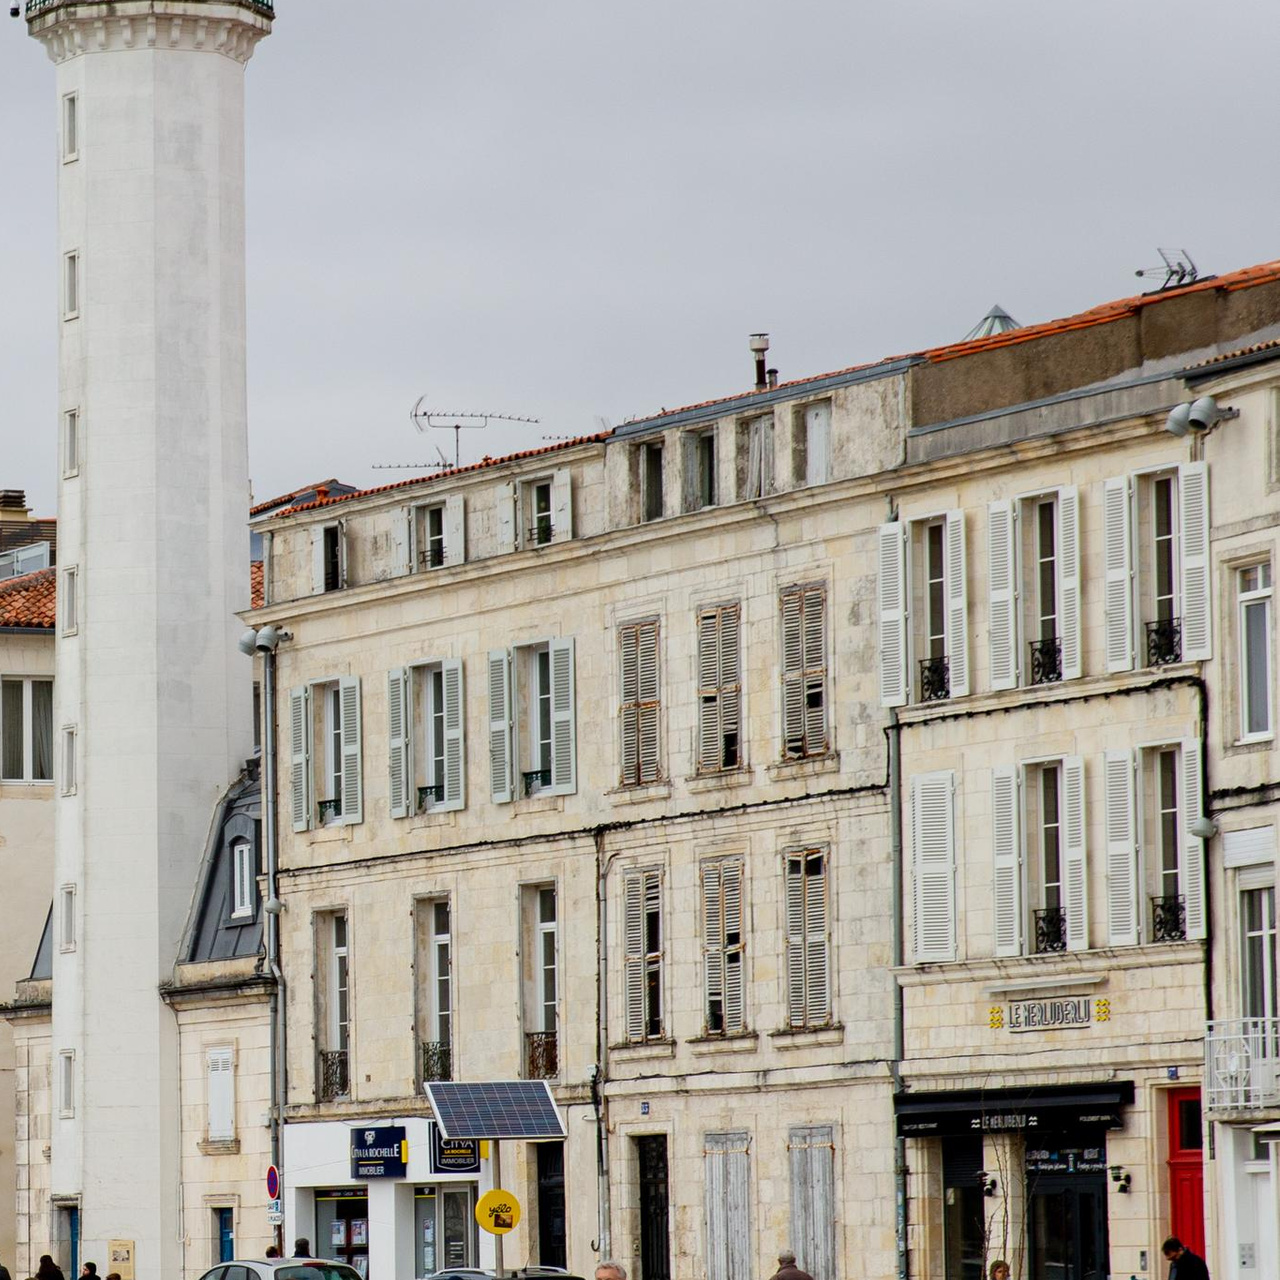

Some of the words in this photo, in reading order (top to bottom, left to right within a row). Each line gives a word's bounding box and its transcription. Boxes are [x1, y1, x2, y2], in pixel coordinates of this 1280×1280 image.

[1009, 1004, 1021, 1028] LE
[369, 1143, 400, 1158] ROCHELLE
[440, 1157, 475, 1165] IMMOBILIER
[358, 1166, 385, 1176] IMMOBILIER
[488, 1203, 512, 1218] yélo
